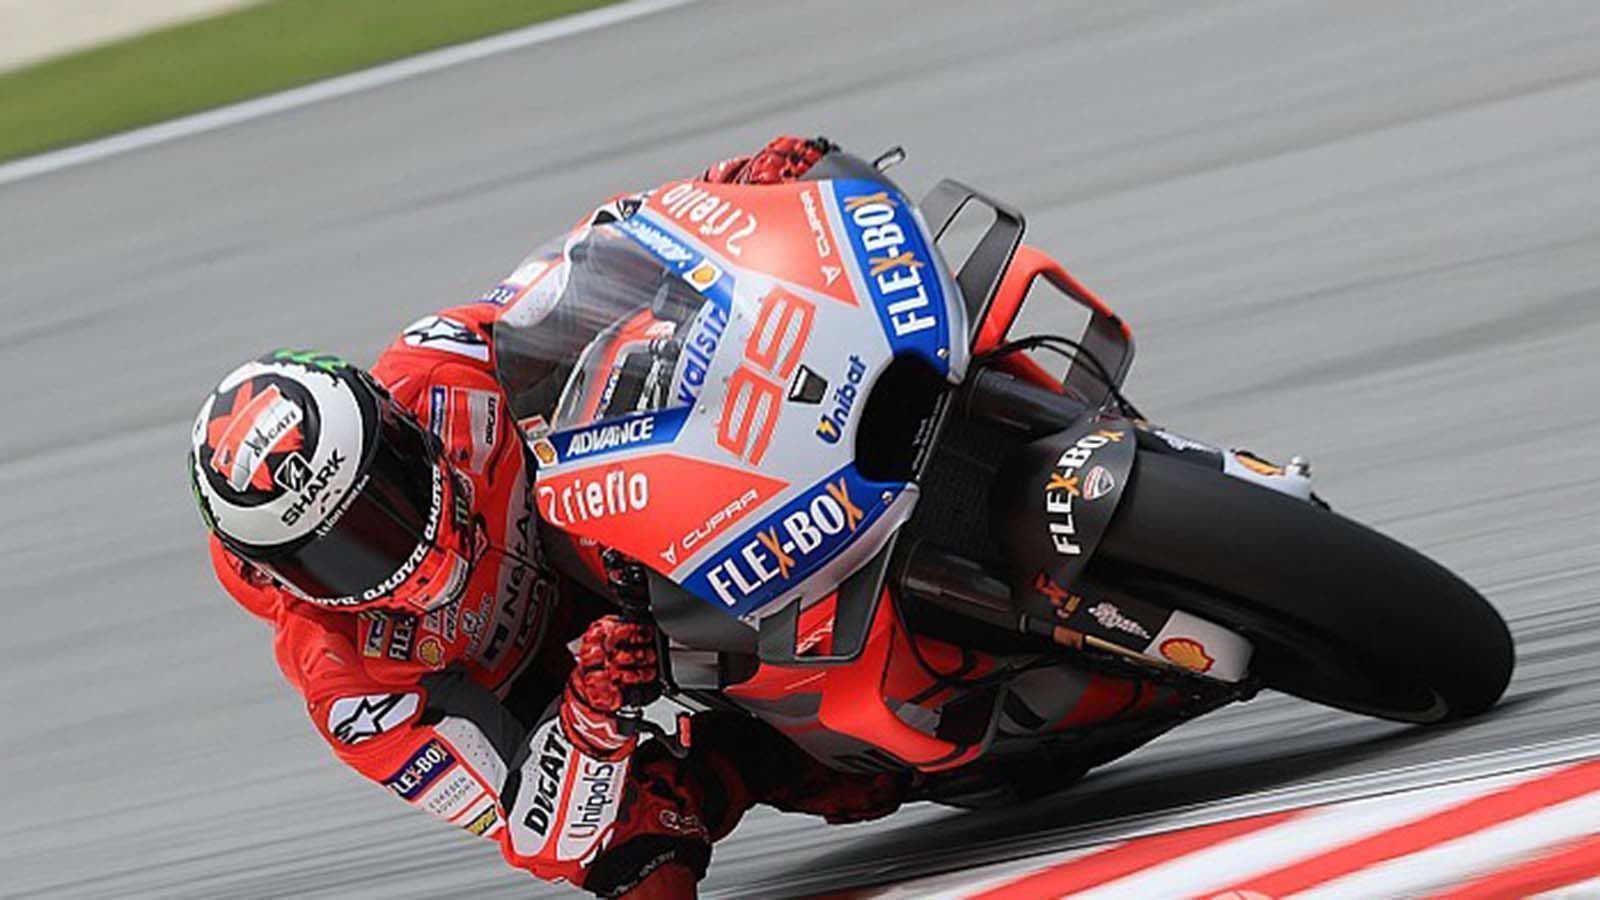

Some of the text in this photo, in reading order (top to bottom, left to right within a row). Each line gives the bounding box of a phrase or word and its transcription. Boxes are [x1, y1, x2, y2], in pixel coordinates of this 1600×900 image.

[845, 191, 937, 337] FLEX-BOX
[566, 416, 656, 457] ADVANCE
[816, 355, 867, 444] Unibat
[281, 449, 347, 526] SHARK
[682, 489, 758, 549] CUPRA
[1045, 429, 1124, 555] FLEX-BOX
[706, 477, 864, 607] FLEX-BOX
